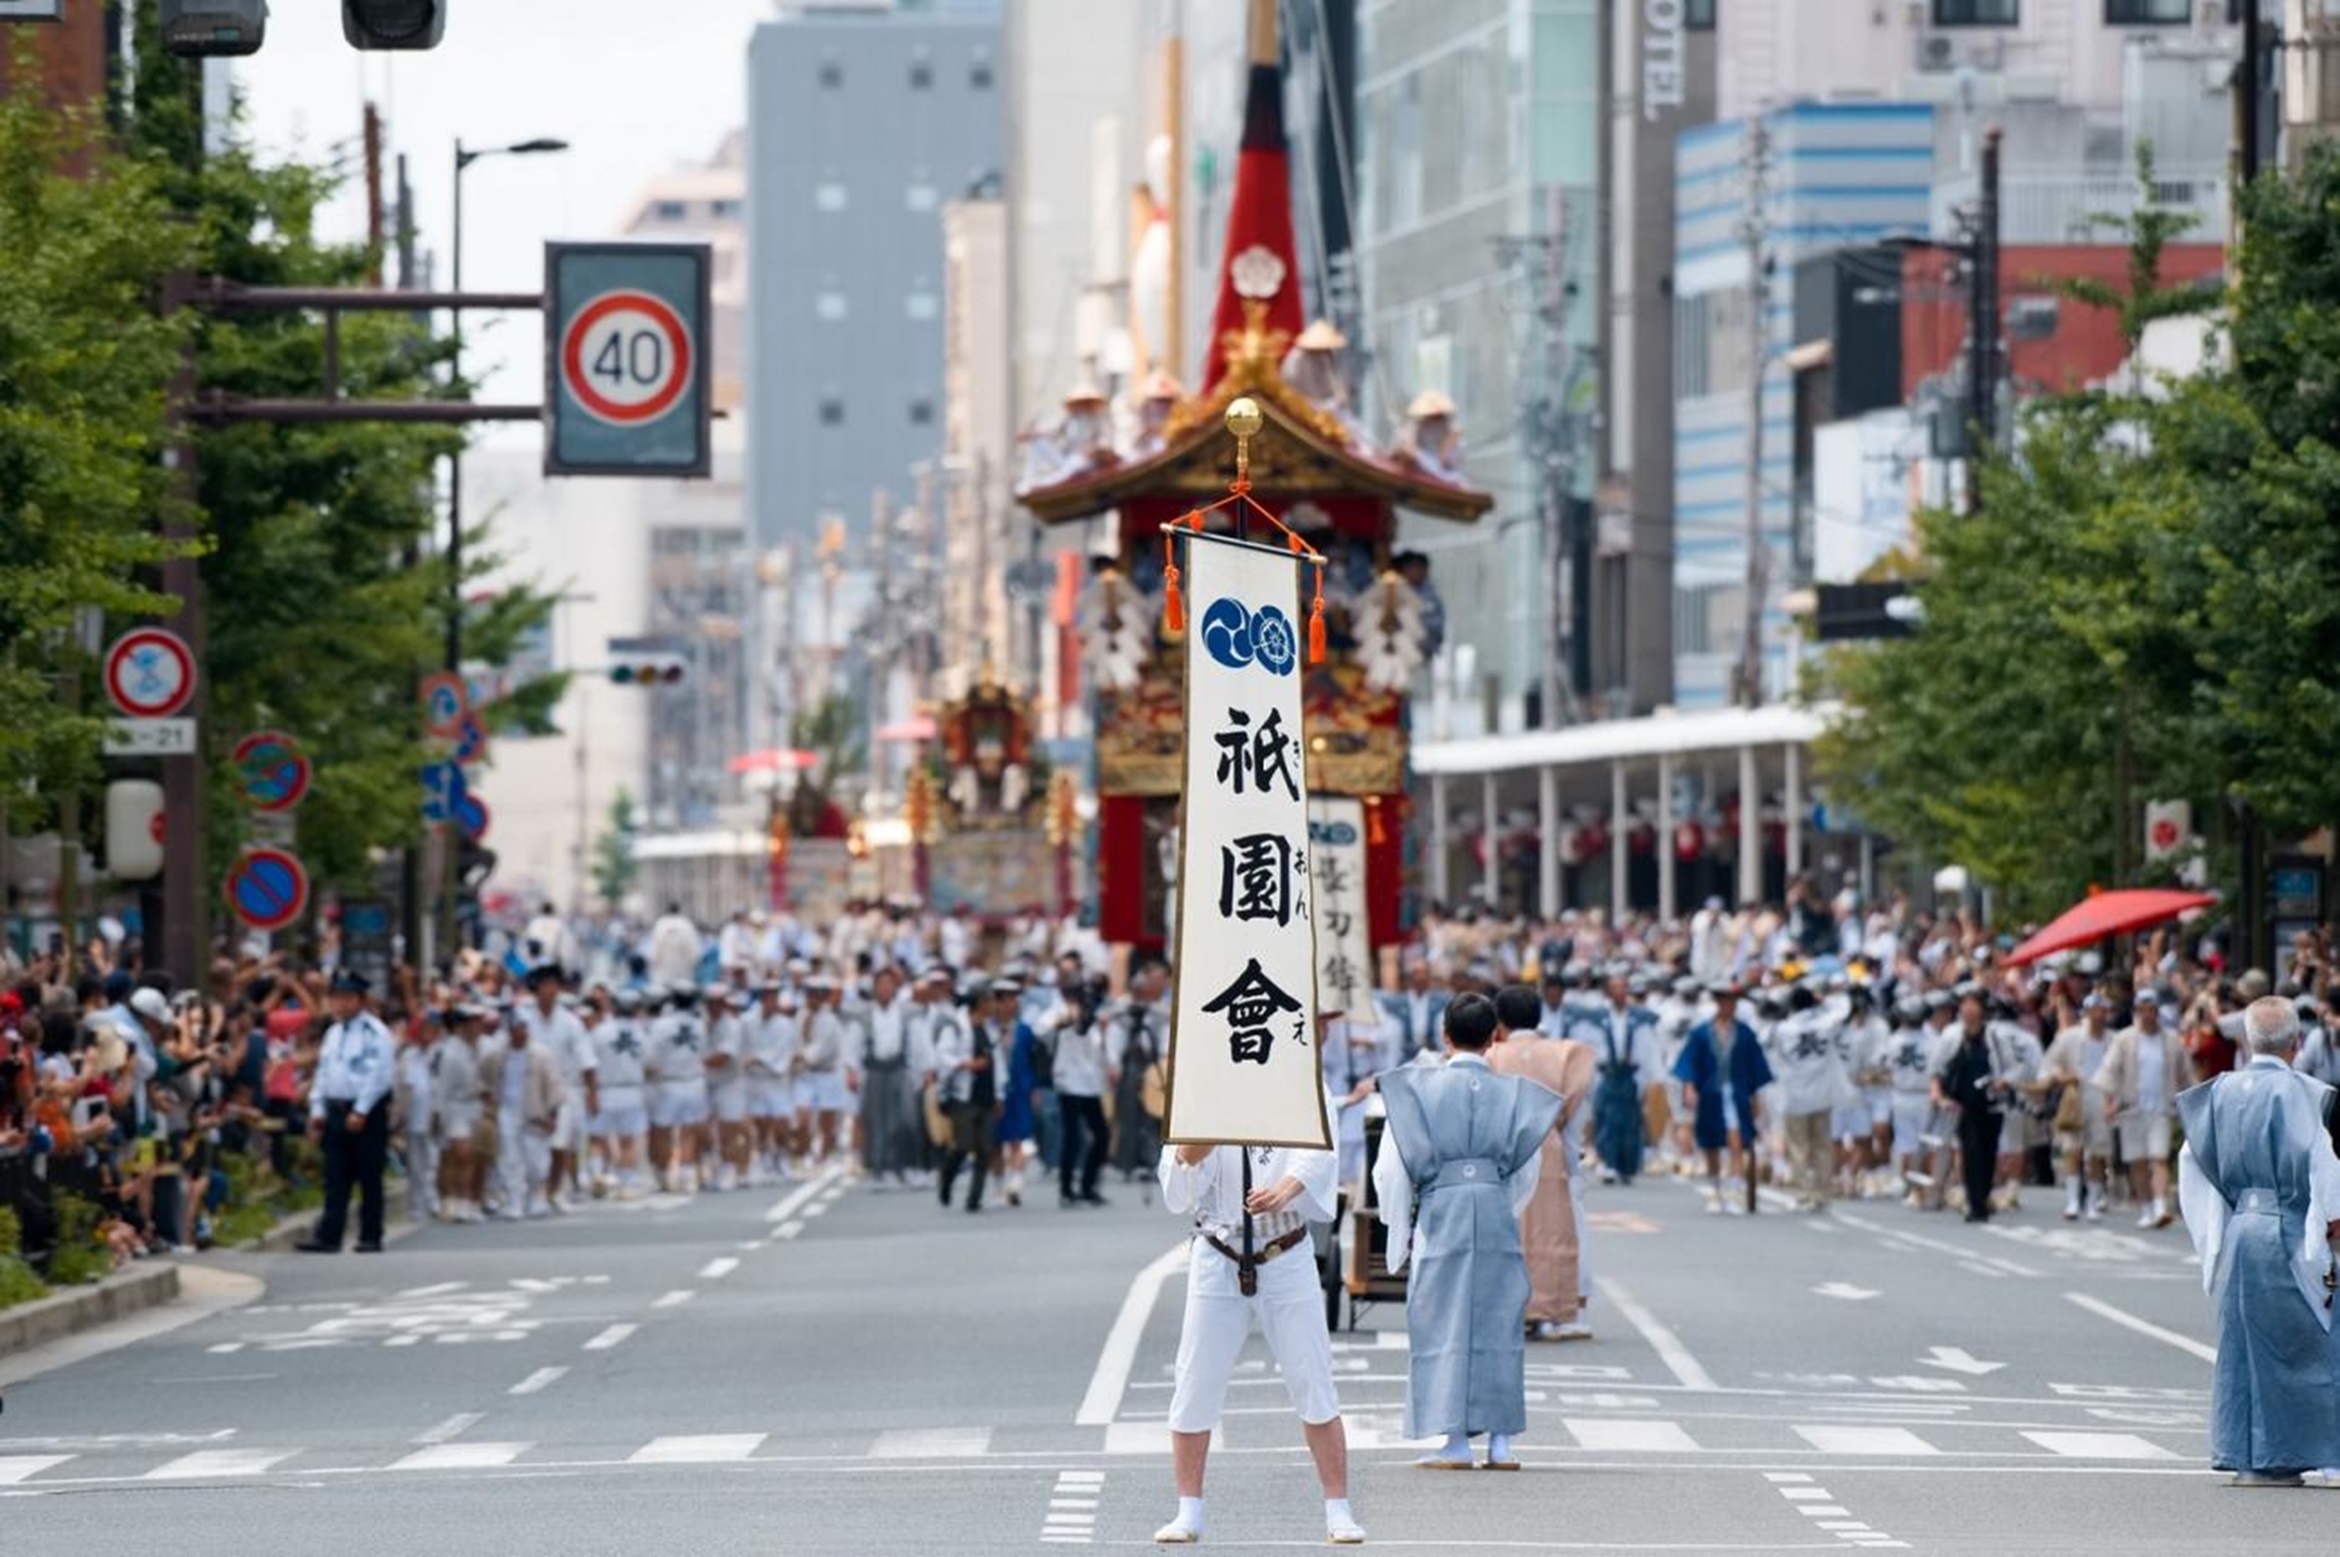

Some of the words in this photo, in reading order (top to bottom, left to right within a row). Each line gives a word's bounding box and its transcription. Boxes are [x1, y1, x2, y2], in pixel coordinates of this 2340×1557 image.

[594, 330, 662, 385] 40
[1201, 707, 1303, 1064] 祇園會
